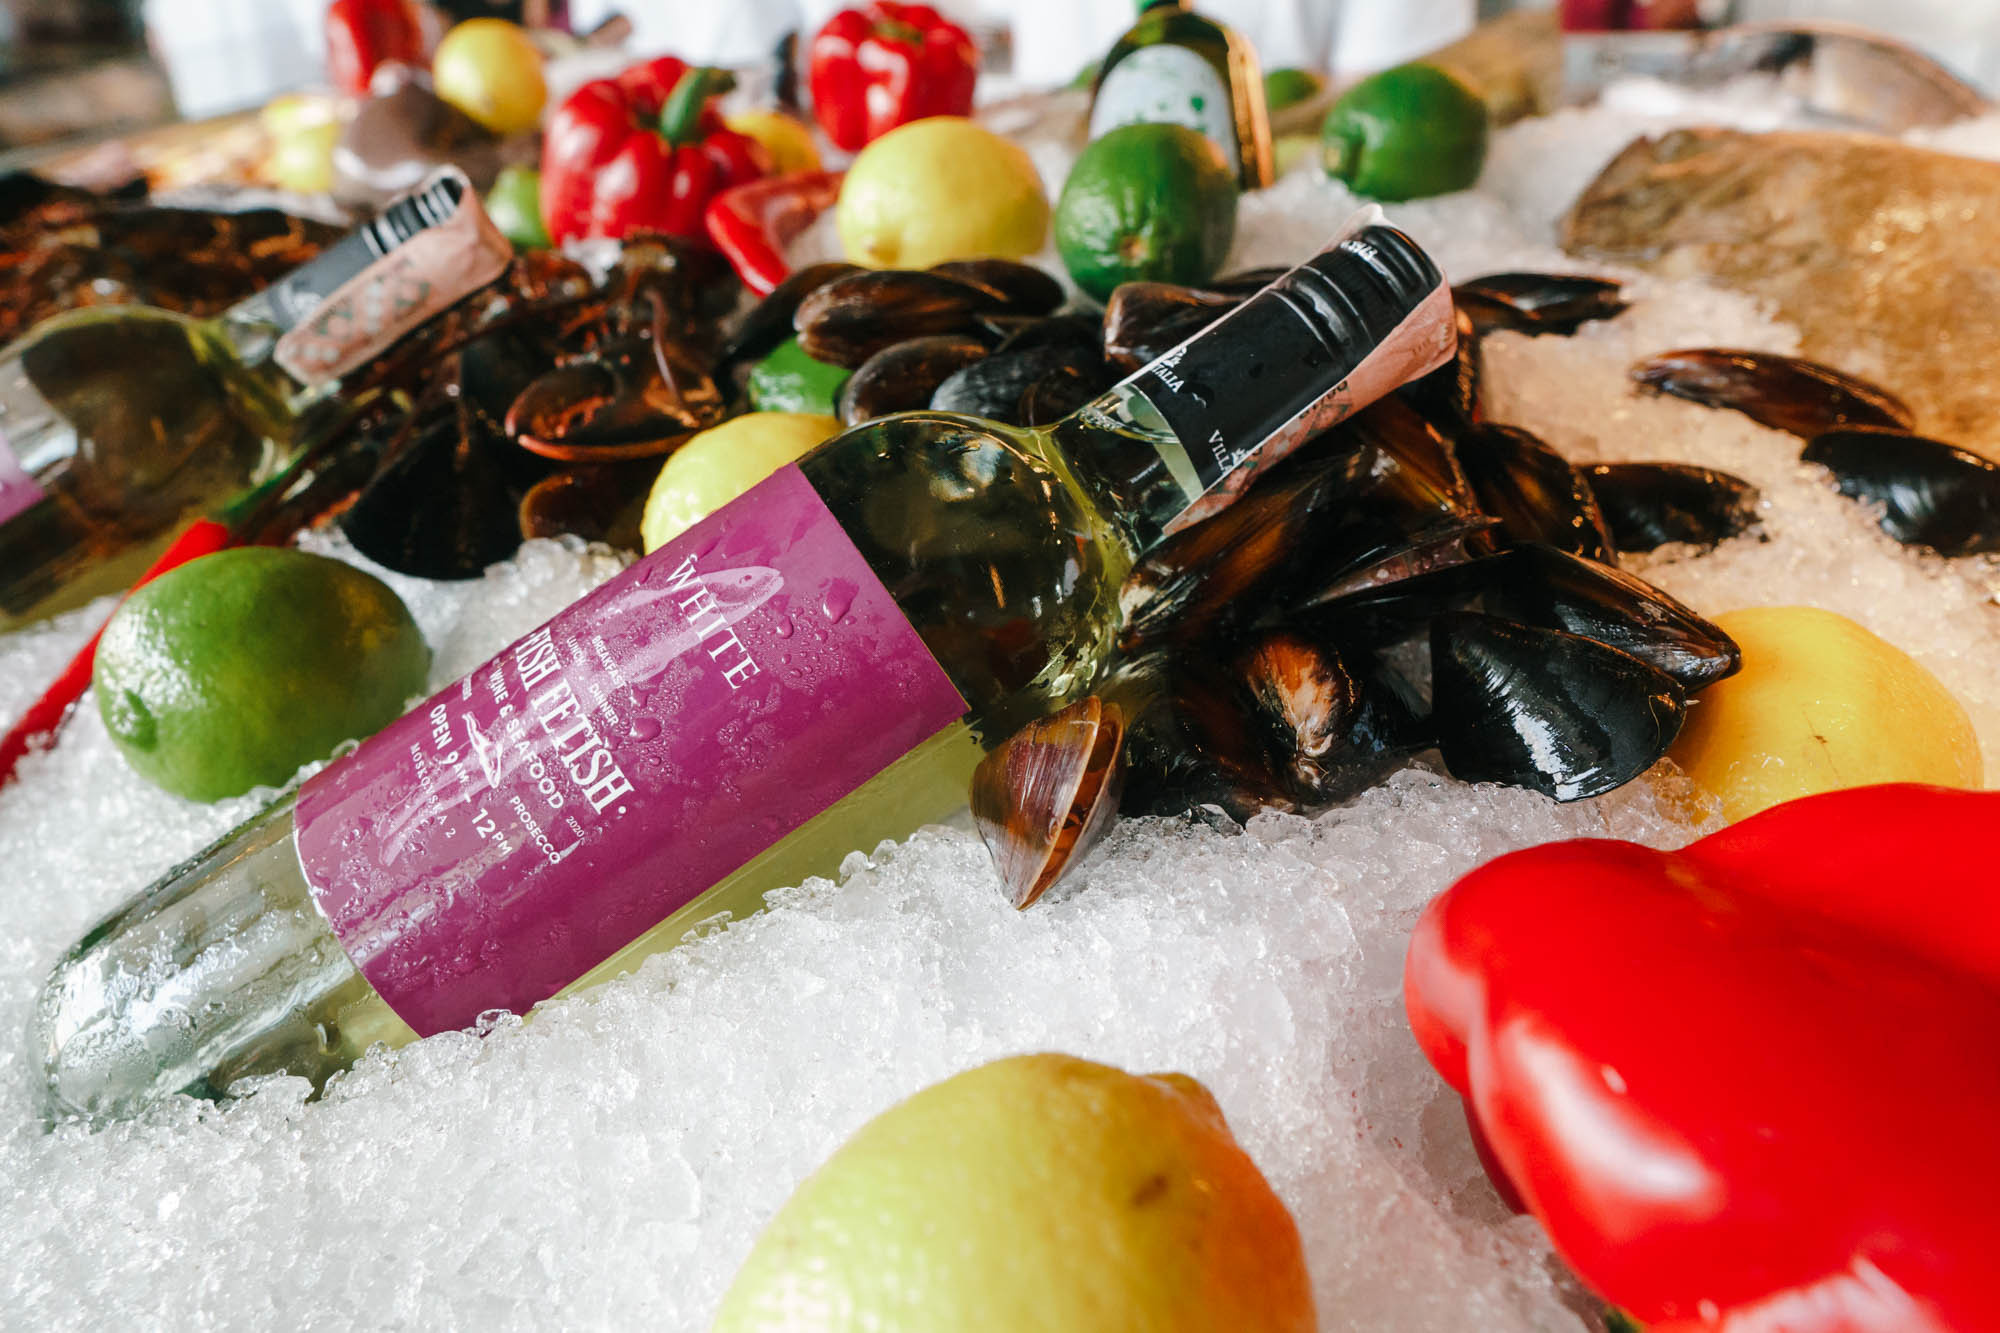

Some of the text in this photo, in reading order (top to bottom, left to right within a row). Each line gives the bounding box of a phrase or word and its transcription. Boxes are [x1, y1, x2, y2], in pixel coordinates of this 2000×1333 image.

[666, 557, 761, 689] WHITE
[516, 628, 561, 691] FISH
[566, 637, 620, 727] LUNCH DINNER
[592, 635, 629, 689] BREAKFAST
[429, 703, 453, 749] OPEN
[489, 667, 564, 810] WINE & SEAFOOD
[509, 795, 561, 865] PROSECCO
[565, 815, 586, 839] 2020
